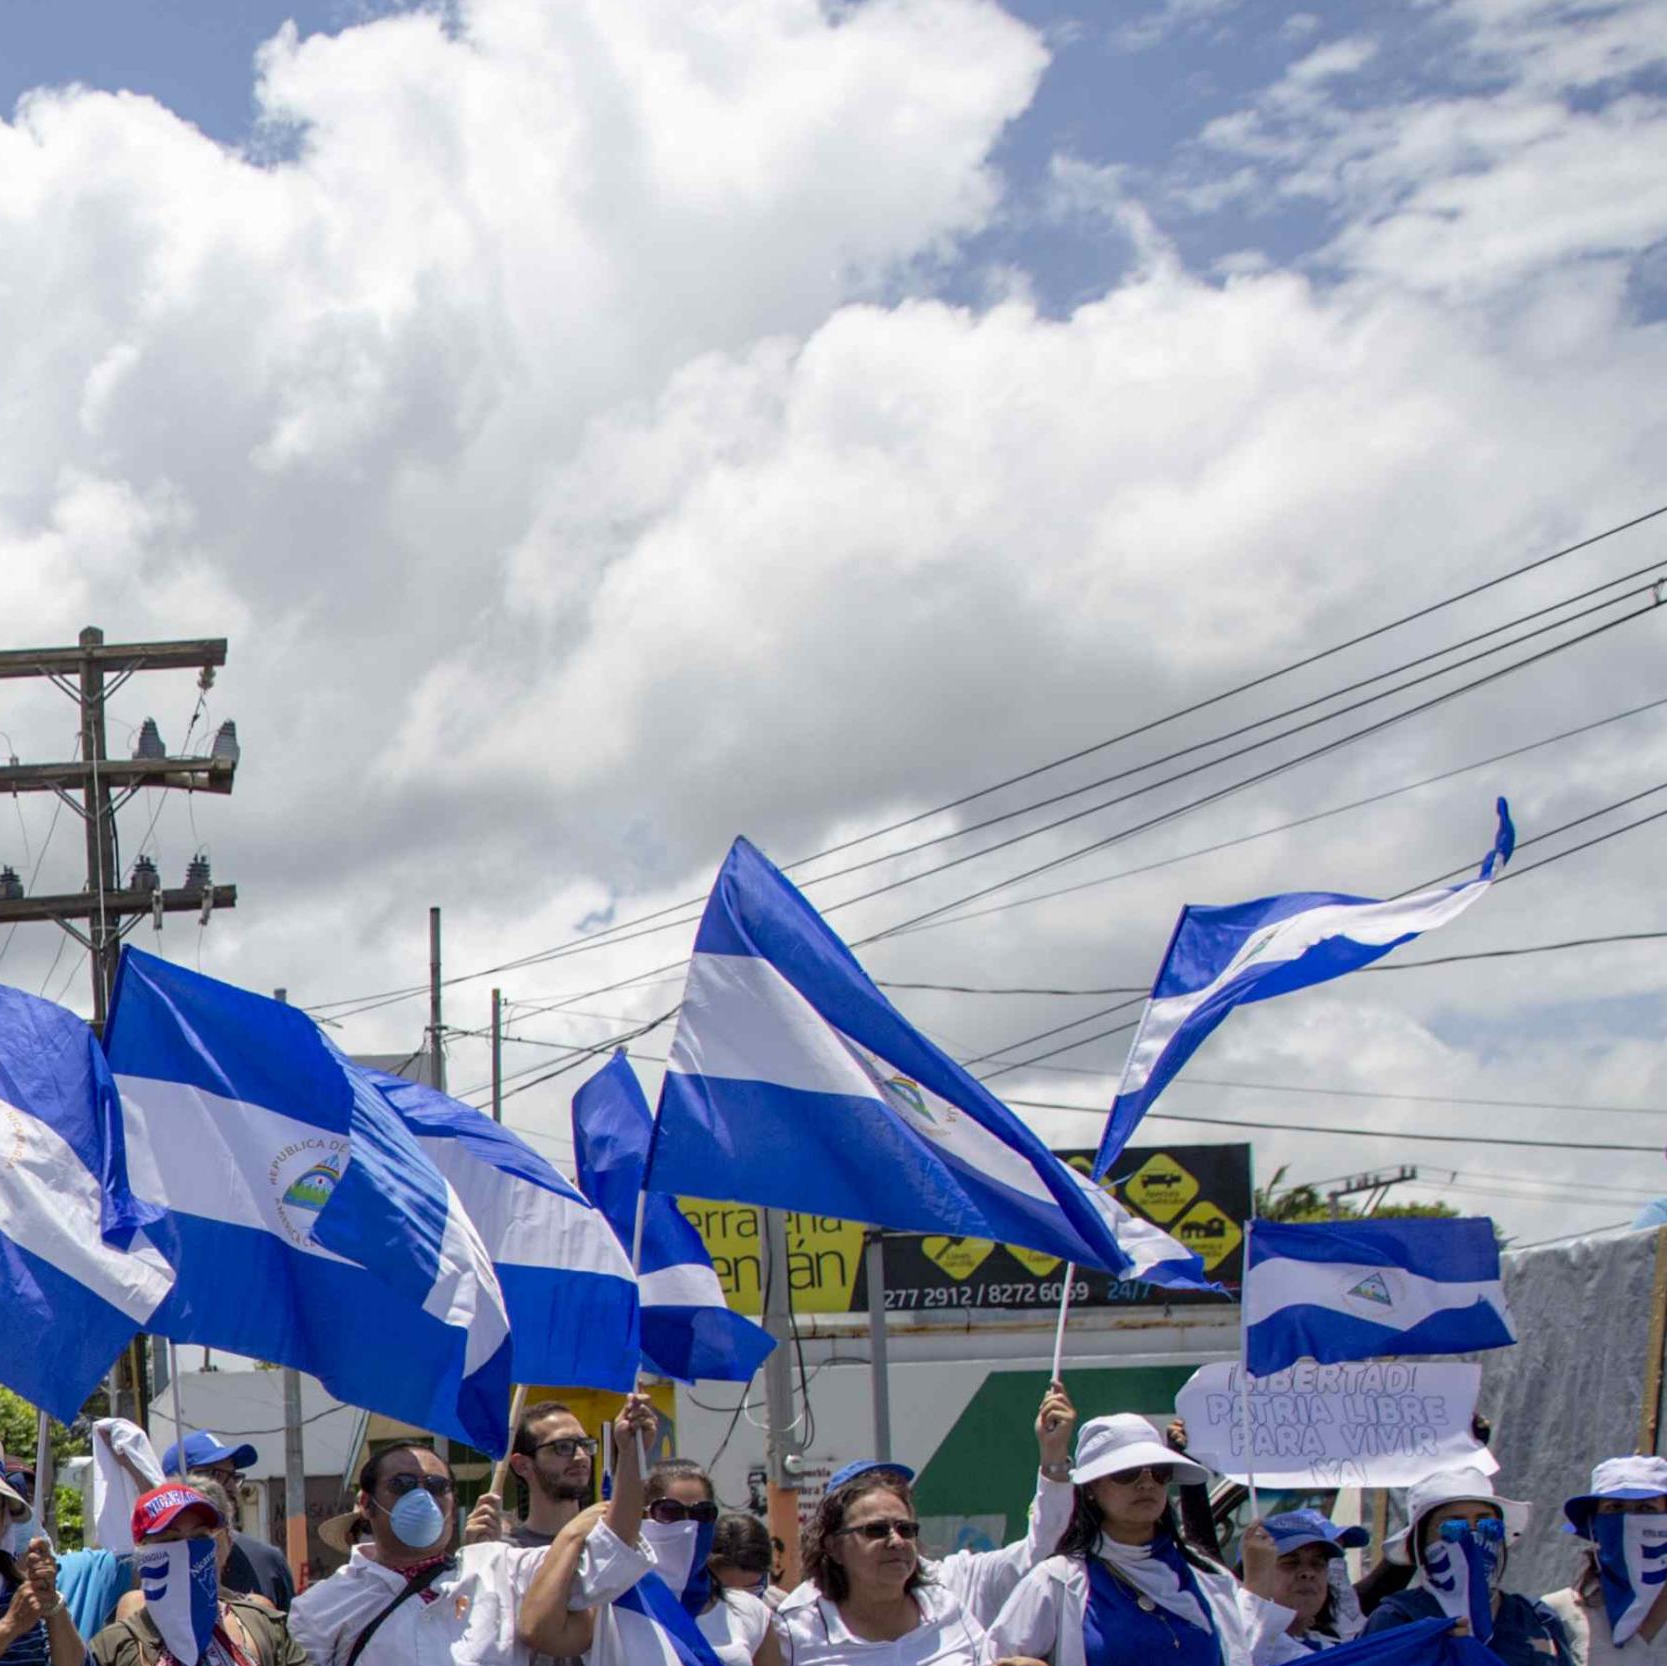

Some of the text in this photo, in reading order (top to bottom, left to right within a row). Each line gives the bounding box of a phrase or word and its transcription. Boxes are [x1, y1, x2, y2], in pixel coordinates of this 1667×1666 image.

[269, 1138, 326, 1186] REPUBLICA
[884, 1287, 918, 1309] 277
[923, 1285, 972, 1307] 2912
[989, 1282, 1036, 1304] 8272
[1205, 1395, 1451, 1426] PATRIA LIBRE
[1229, 1423, 1441, 1459] PARA VIVIR
